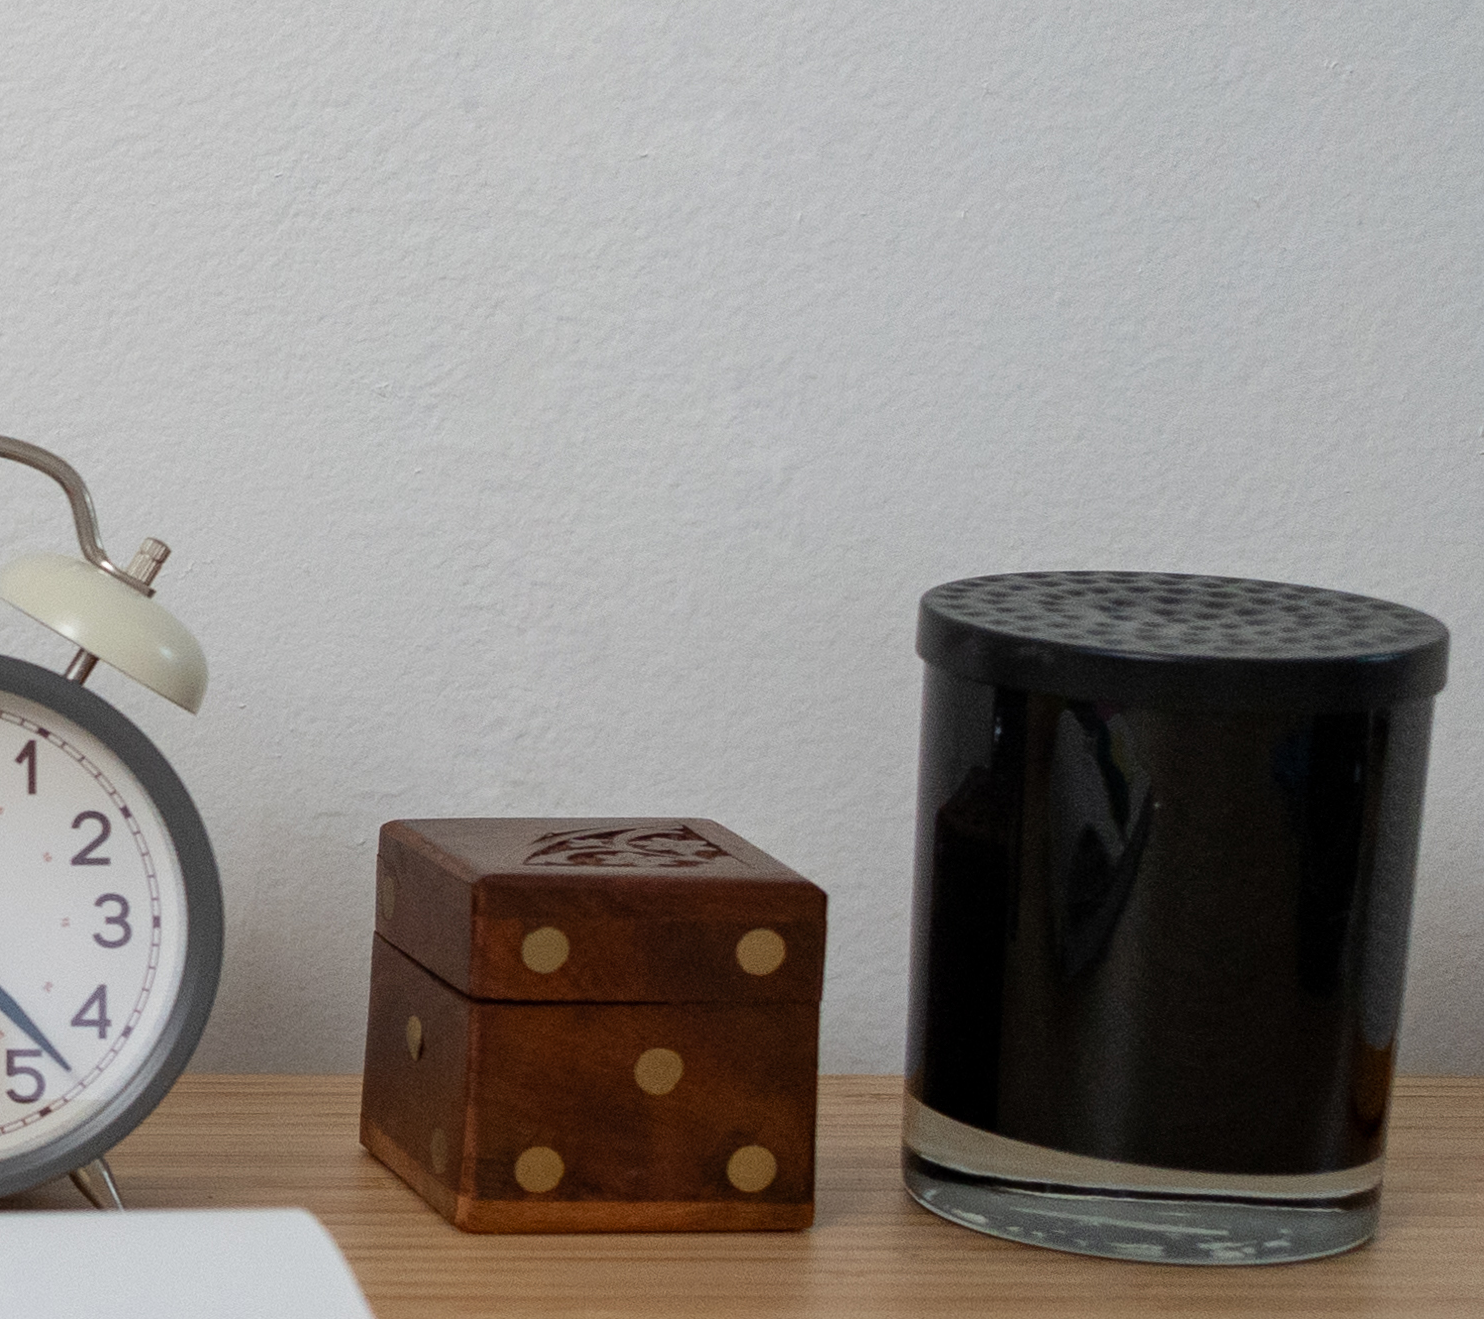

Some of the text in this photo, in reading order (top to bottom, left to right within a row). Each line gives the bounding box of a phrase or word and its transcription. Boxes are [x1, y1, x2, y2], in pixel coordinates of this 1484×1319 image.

[14, 739, 37, 795] 1
[70, 810, 112, 866] 2
[92, 892, 133, 949] 3
[70, 983, 112, 1040] 4
[5, 1047, 47, 1105] 5
